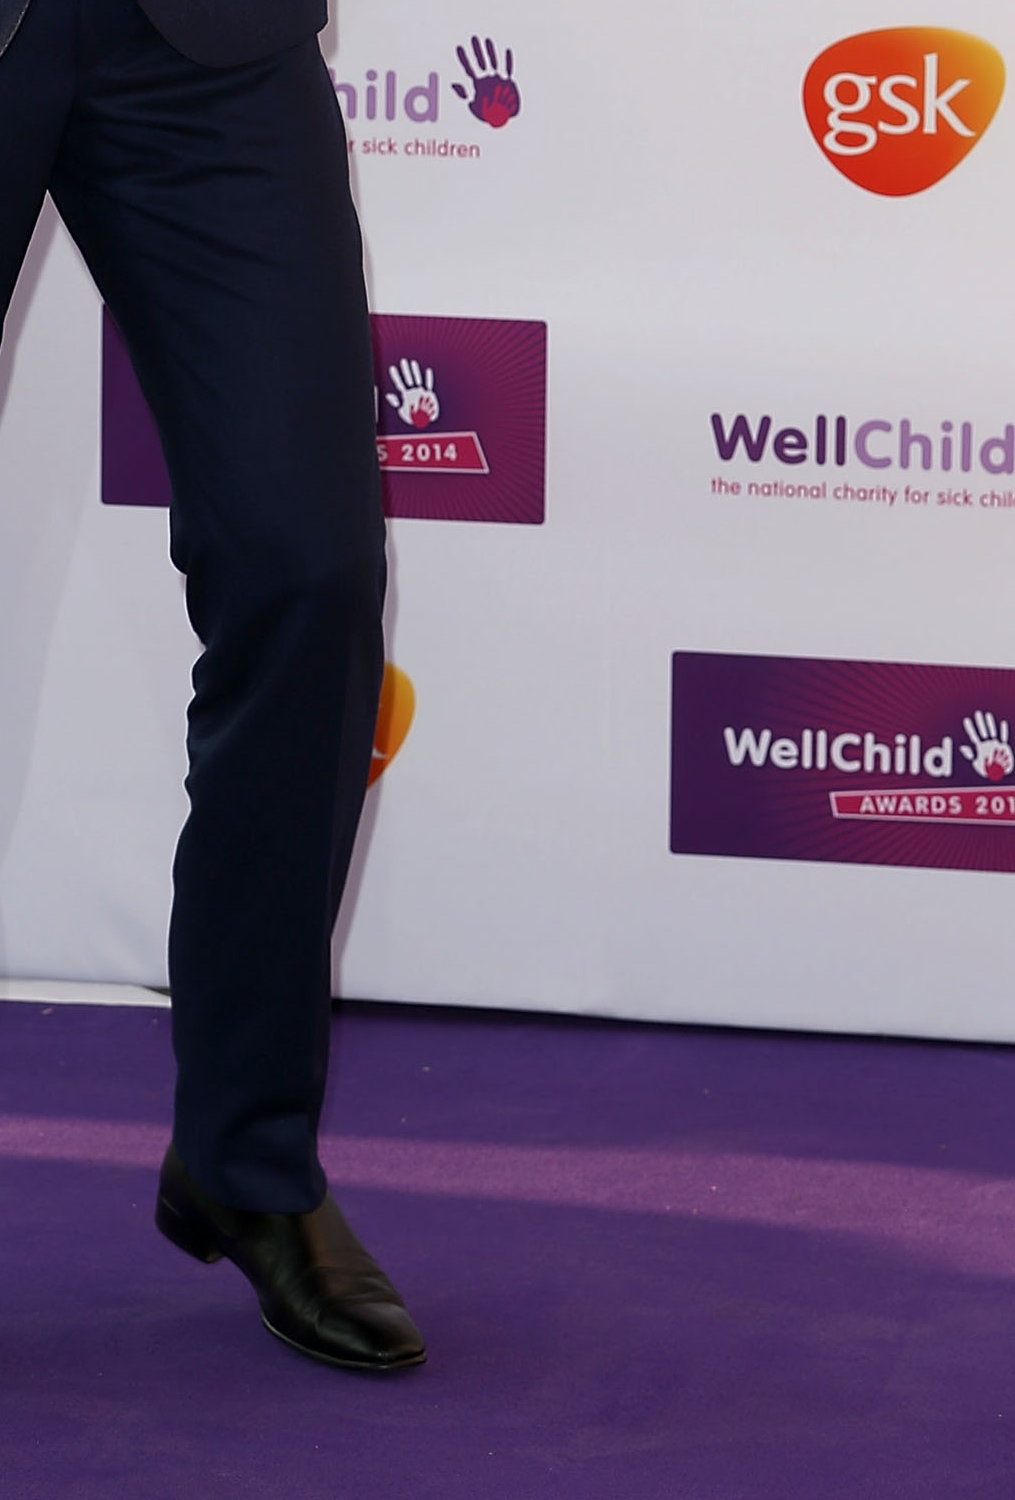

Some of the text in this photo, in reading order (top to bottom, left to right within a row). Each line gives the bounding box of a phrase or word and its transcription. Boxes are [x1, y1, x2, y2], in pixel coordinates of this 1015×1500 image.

[823, 52, 977, 157] gsk
[361, 136, 398, 155] sick
[403, 138, 481, 159] children
[400, 443, 458, 462] 2014
[711, 413, 1015, 475] WellChild
[711, 477, 742, 496] the
[747, 479, 827, 500] national
[832, 481, 898, 507] charity
[904, 484, 930, 505] for
[937, 487, 973, 507] sick
[723, 726, 953, 777] WellChild
[859, 795, 963, 815] AWARDS
